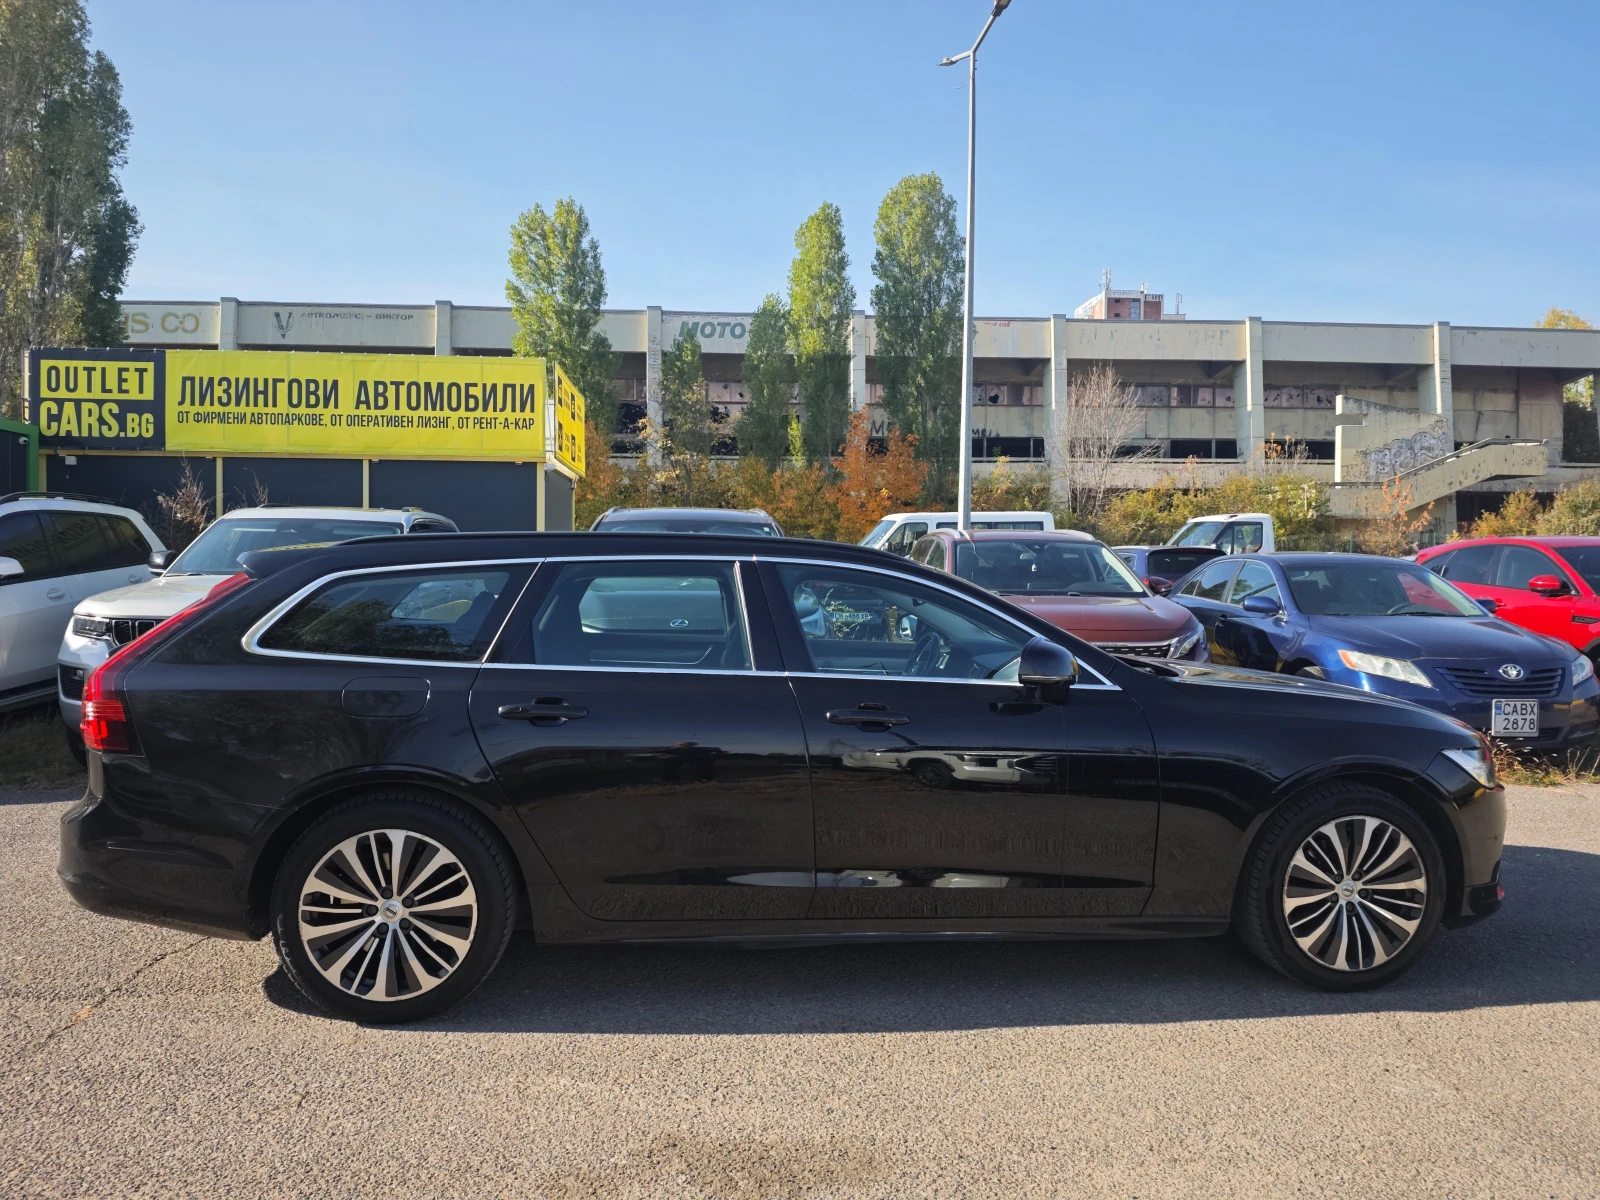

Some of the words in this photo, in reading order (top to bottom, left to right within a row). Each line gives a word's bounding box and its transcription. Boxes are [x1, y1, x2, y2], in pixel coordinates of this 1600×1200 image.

[46, 365, 149, 395] OUTLET
[177, 375, 339, 409] ЛИЗИНГОВИ
[354, 380, 535, 413] АВТОМОБИЛИ
[177, 411, 191, 424] ОТ
[193, 411, 247, 425] ФИРМЕНИ
[249, 412, 328, 428] АВТОПАРКОВЕ,
[330, 414, 344, 427] ОТ
[346, 414, 414, 429] ОПЕРАТИВЕН
[457, 416, 471, 430] ОТ
[473, 417, 535, 430] РЕНТ-А-КАР
[1503, 703, 1536, 716] CABX
[1503, 718, 1536, 730] 2878
